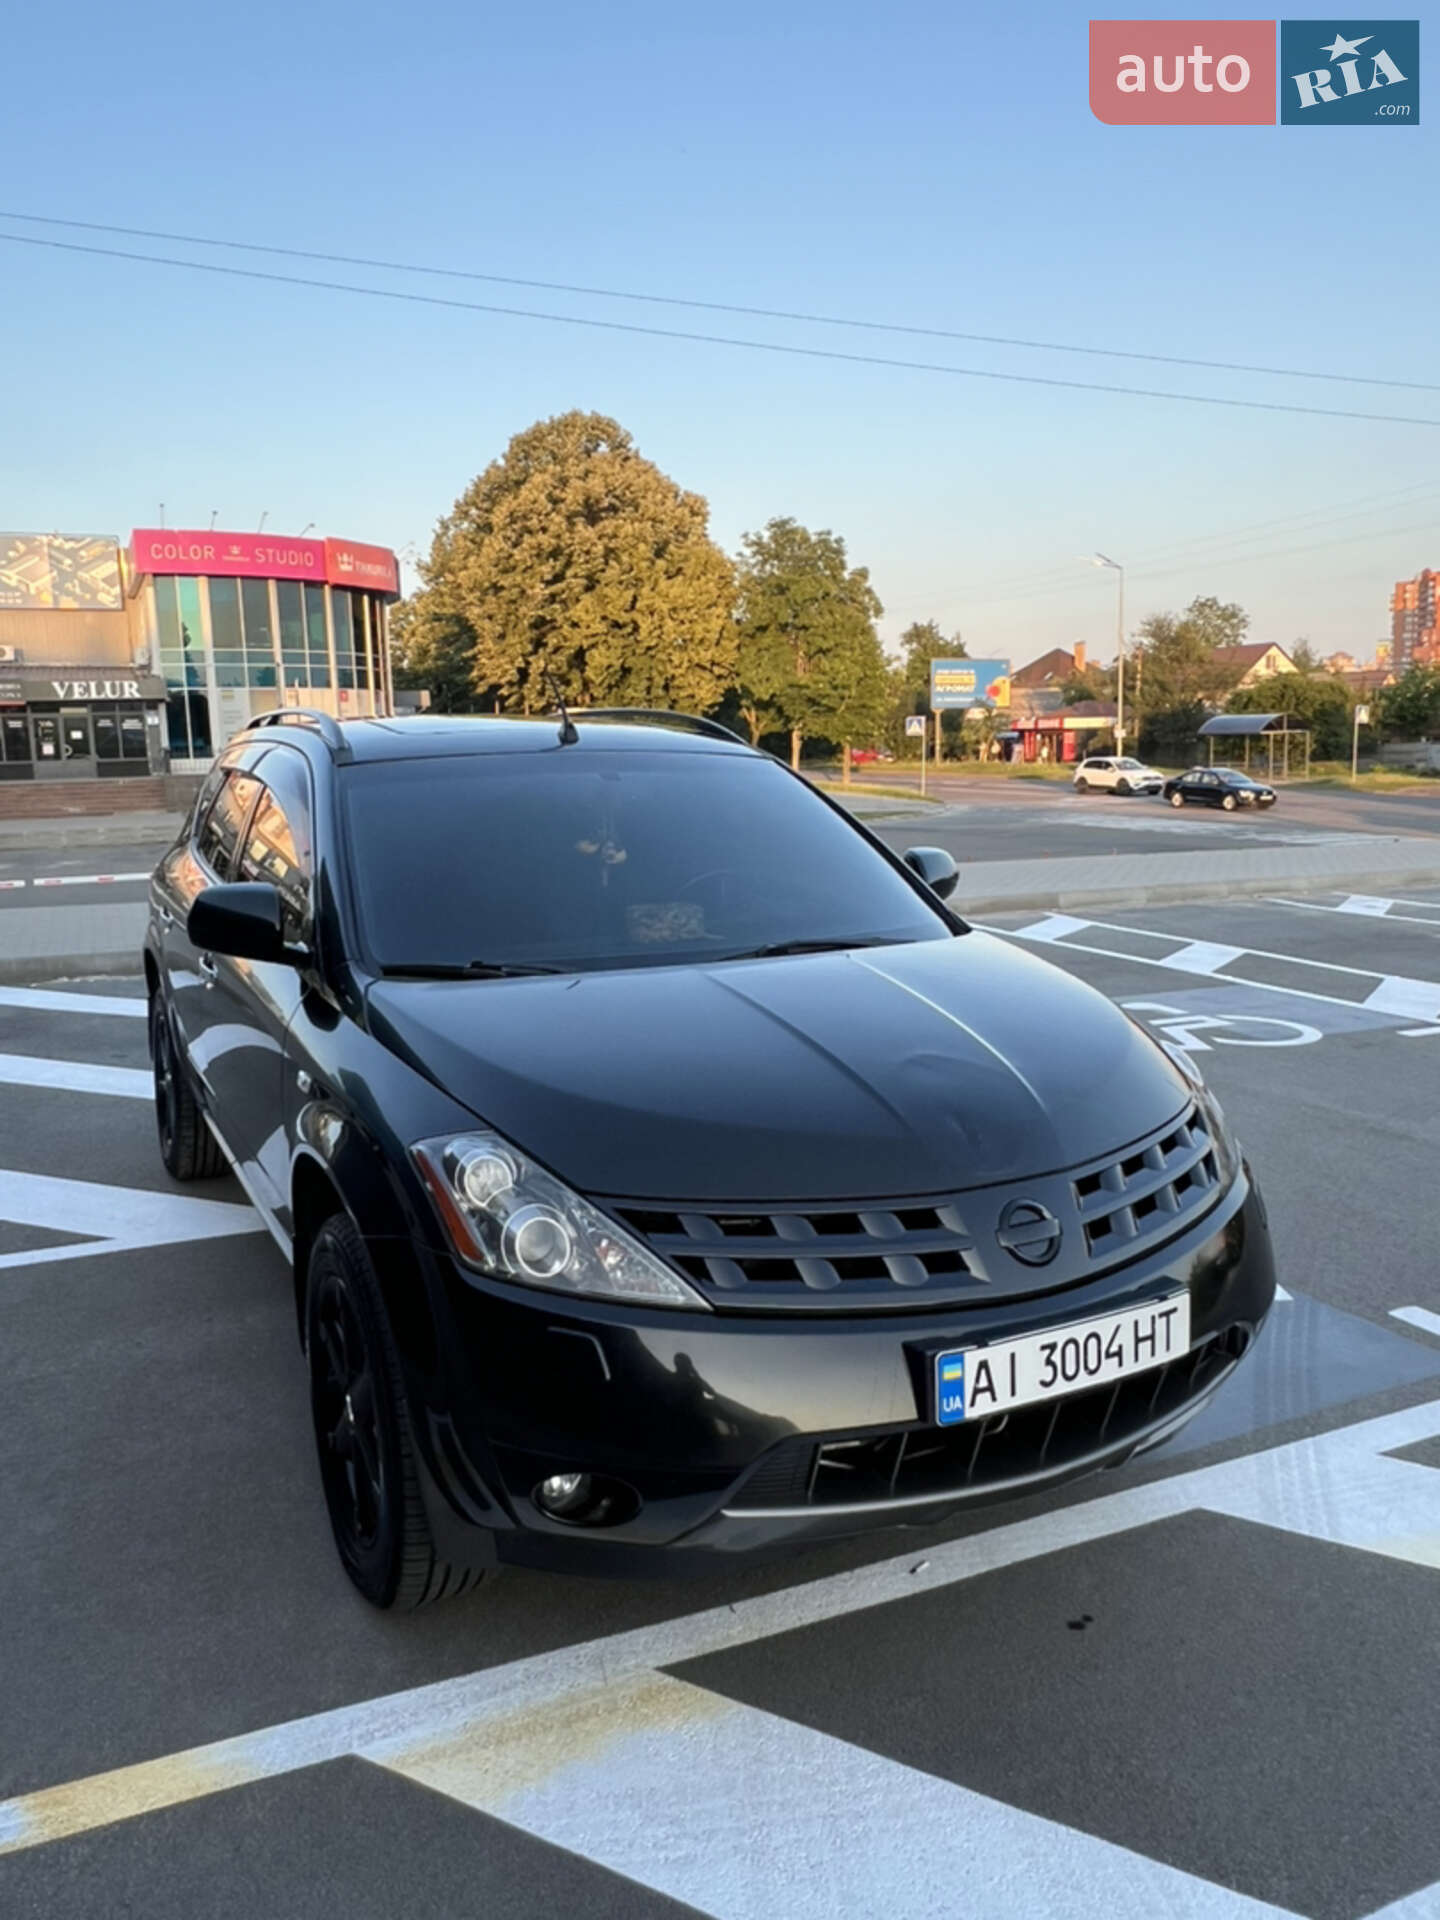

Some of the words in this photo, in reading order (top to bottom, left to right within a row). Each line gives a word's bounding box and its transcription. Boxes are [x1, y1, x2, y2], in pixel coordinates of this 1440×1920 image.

[150, 543, 215, 560] COLOR
[255, 548, 315, 567] STUDIO
[52, 680, 141, 699] VELUR
[1039, 1324, 1124, 1388] 3004
[942, 1395, 963, 1413] UA
